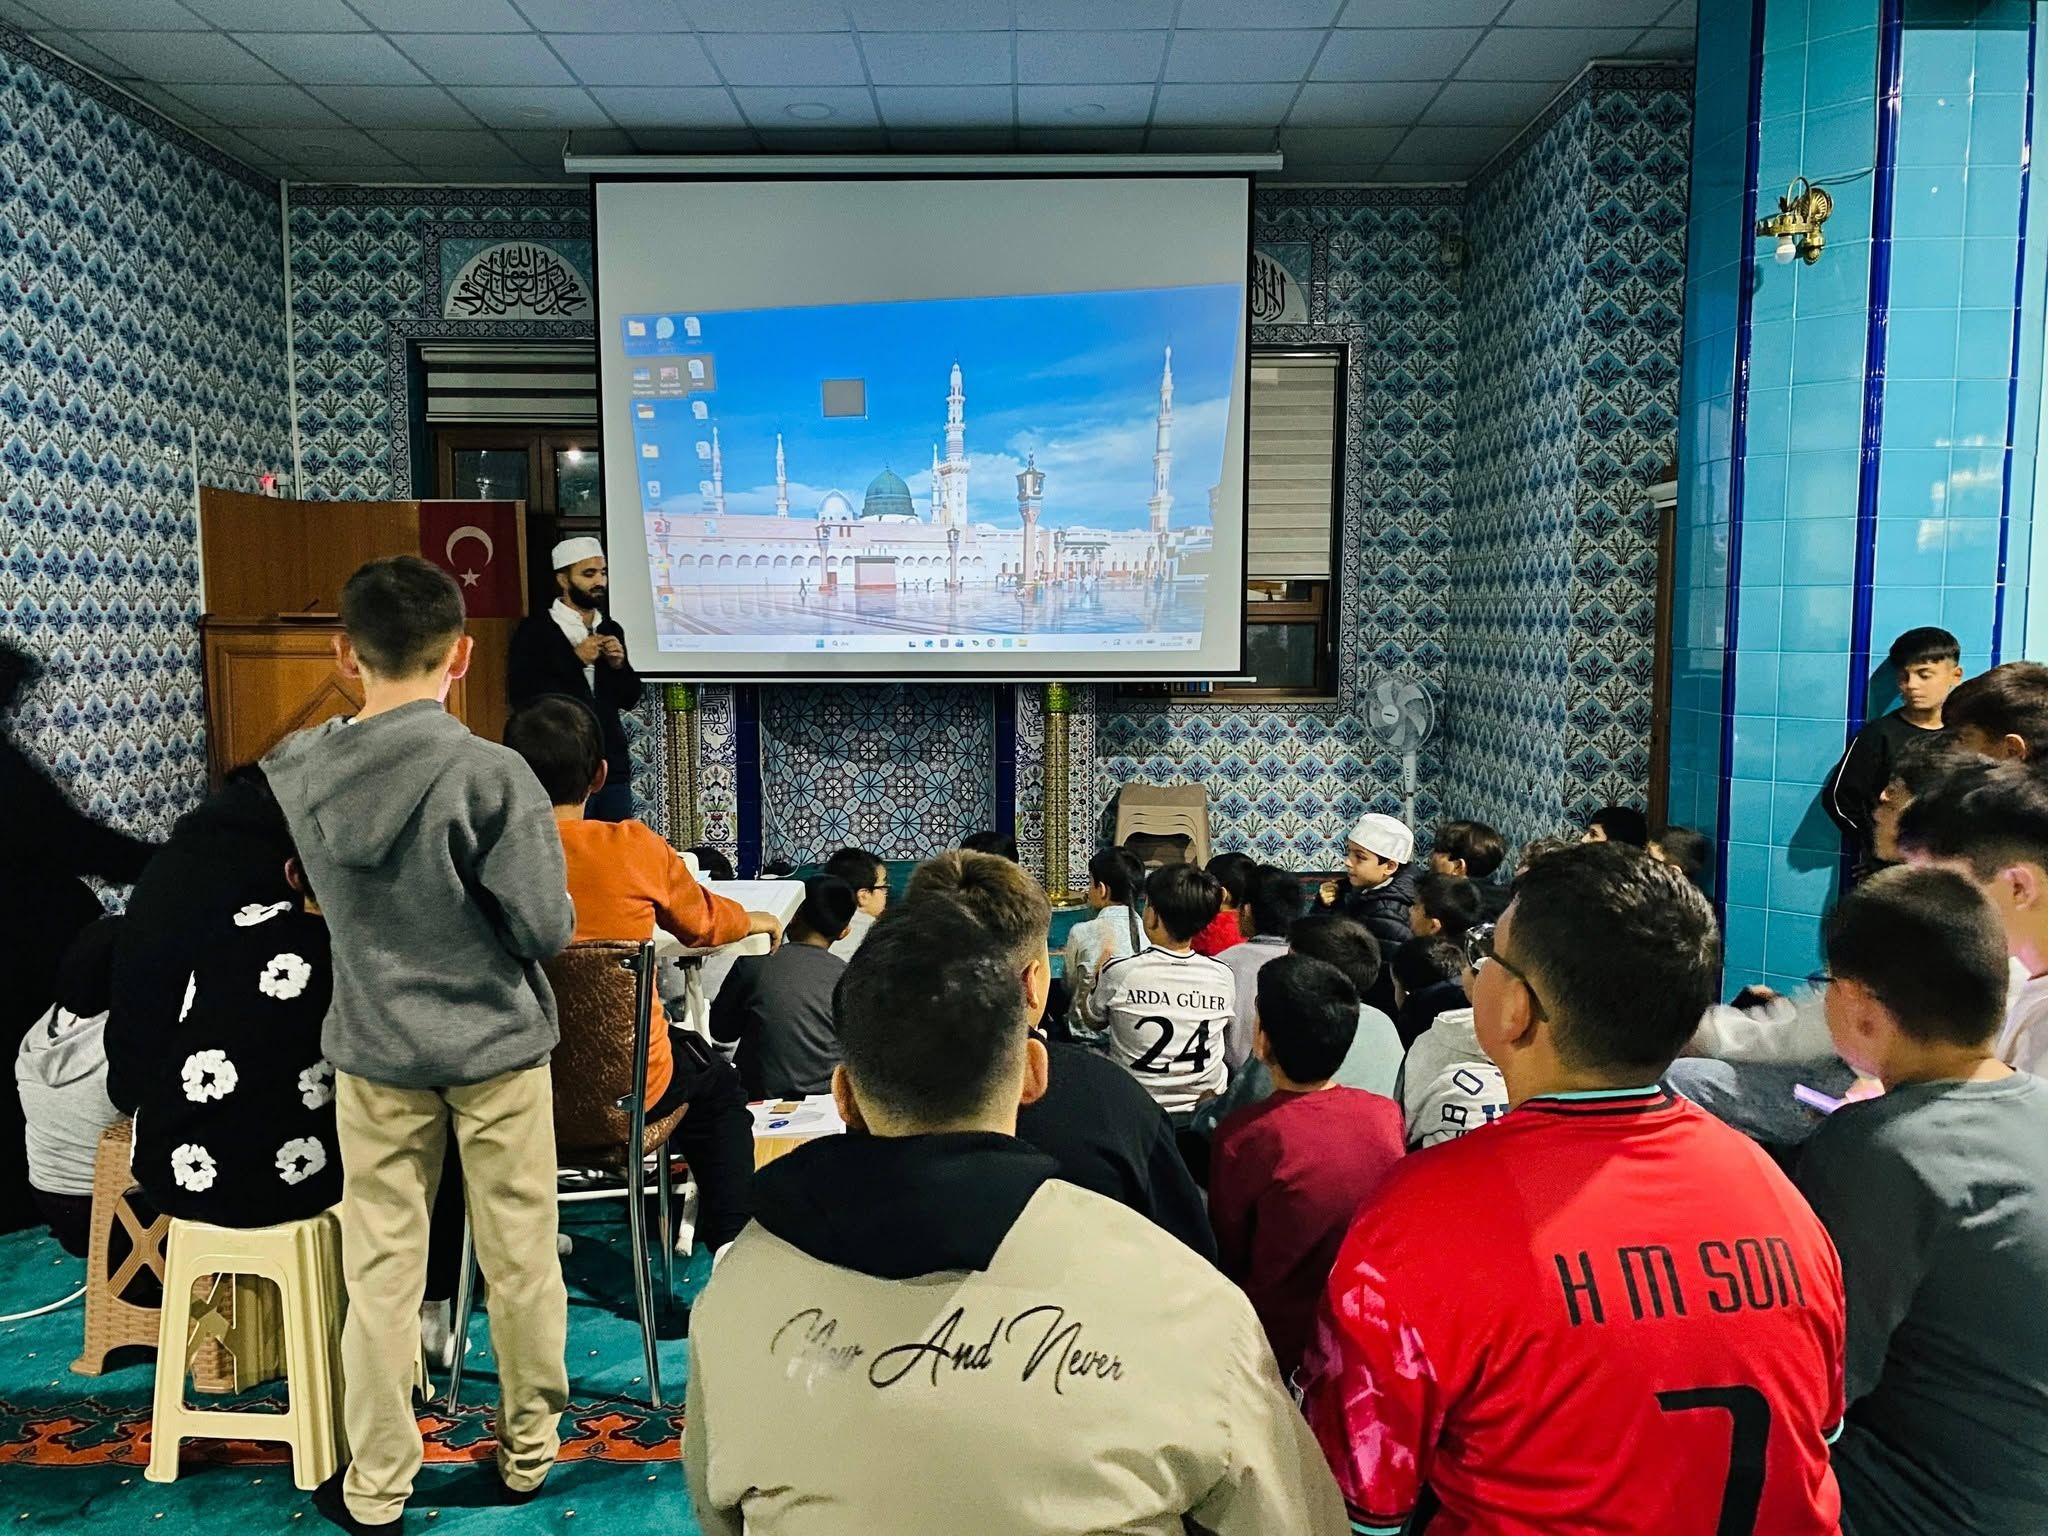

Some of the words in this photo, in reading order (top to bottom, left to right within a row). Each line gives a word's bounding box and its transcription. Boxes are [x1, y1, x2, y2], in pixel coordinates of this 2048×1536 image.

[1126, 989, 1171, 1006] ARDA
[1176, 990, 1226, 1011] GÜLER
[1129, 1015, 1211, 1074] 24
[1553, 1250, 1605, 1328] H
[868, 1306, 1004, 1388] And
[1005, 1305, 1125, 1395] Never
[1653, 1385, 1773, 1536] 7
